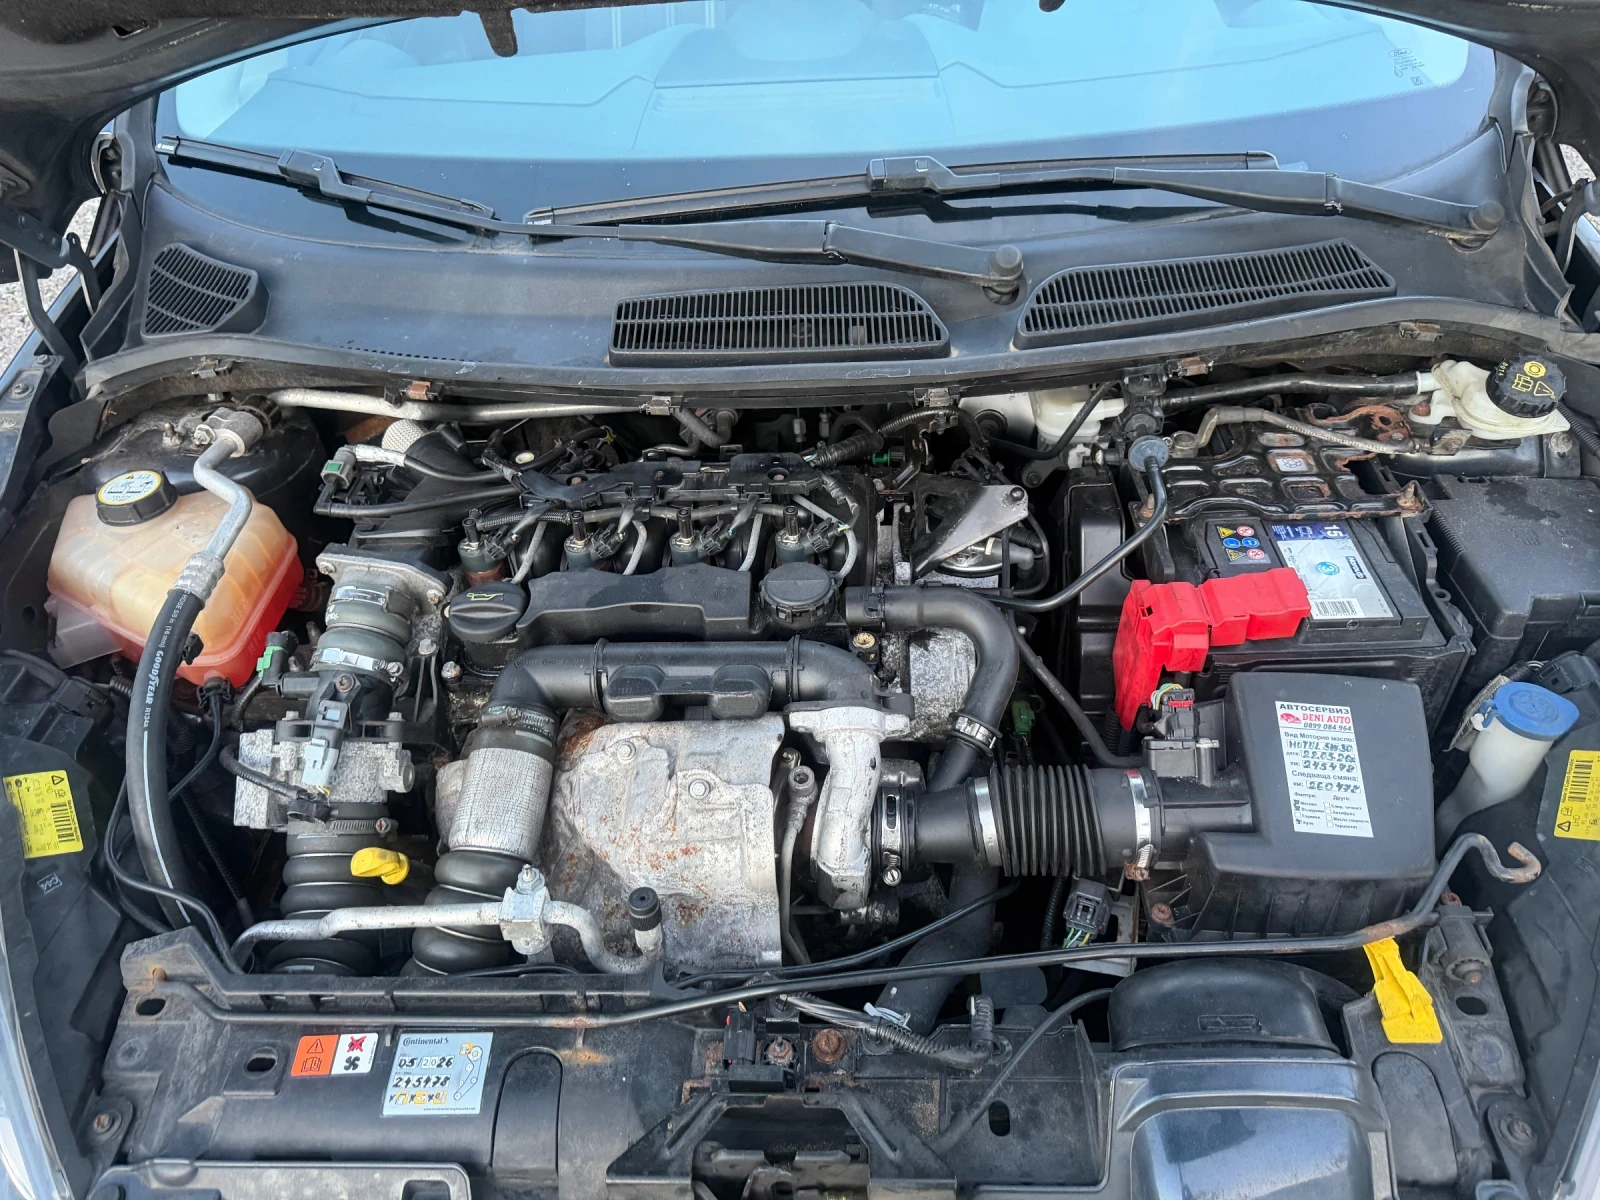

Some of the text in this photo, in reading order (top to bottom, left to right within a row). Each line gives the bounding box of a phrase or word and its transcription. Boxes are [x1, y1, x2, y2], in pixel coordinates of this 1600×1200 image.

[1323, 524, 1344, 537] 15
[145, 650, 164, 705] GOODYEAR
[1280, 704, 1350, 715] АВТОСЕРВИЗ
[1302, 712, 1351, 724] DENI AUTO
[1303, 722, 1321, 730] 0899
[403, 1037, 443, 1046] Continental
